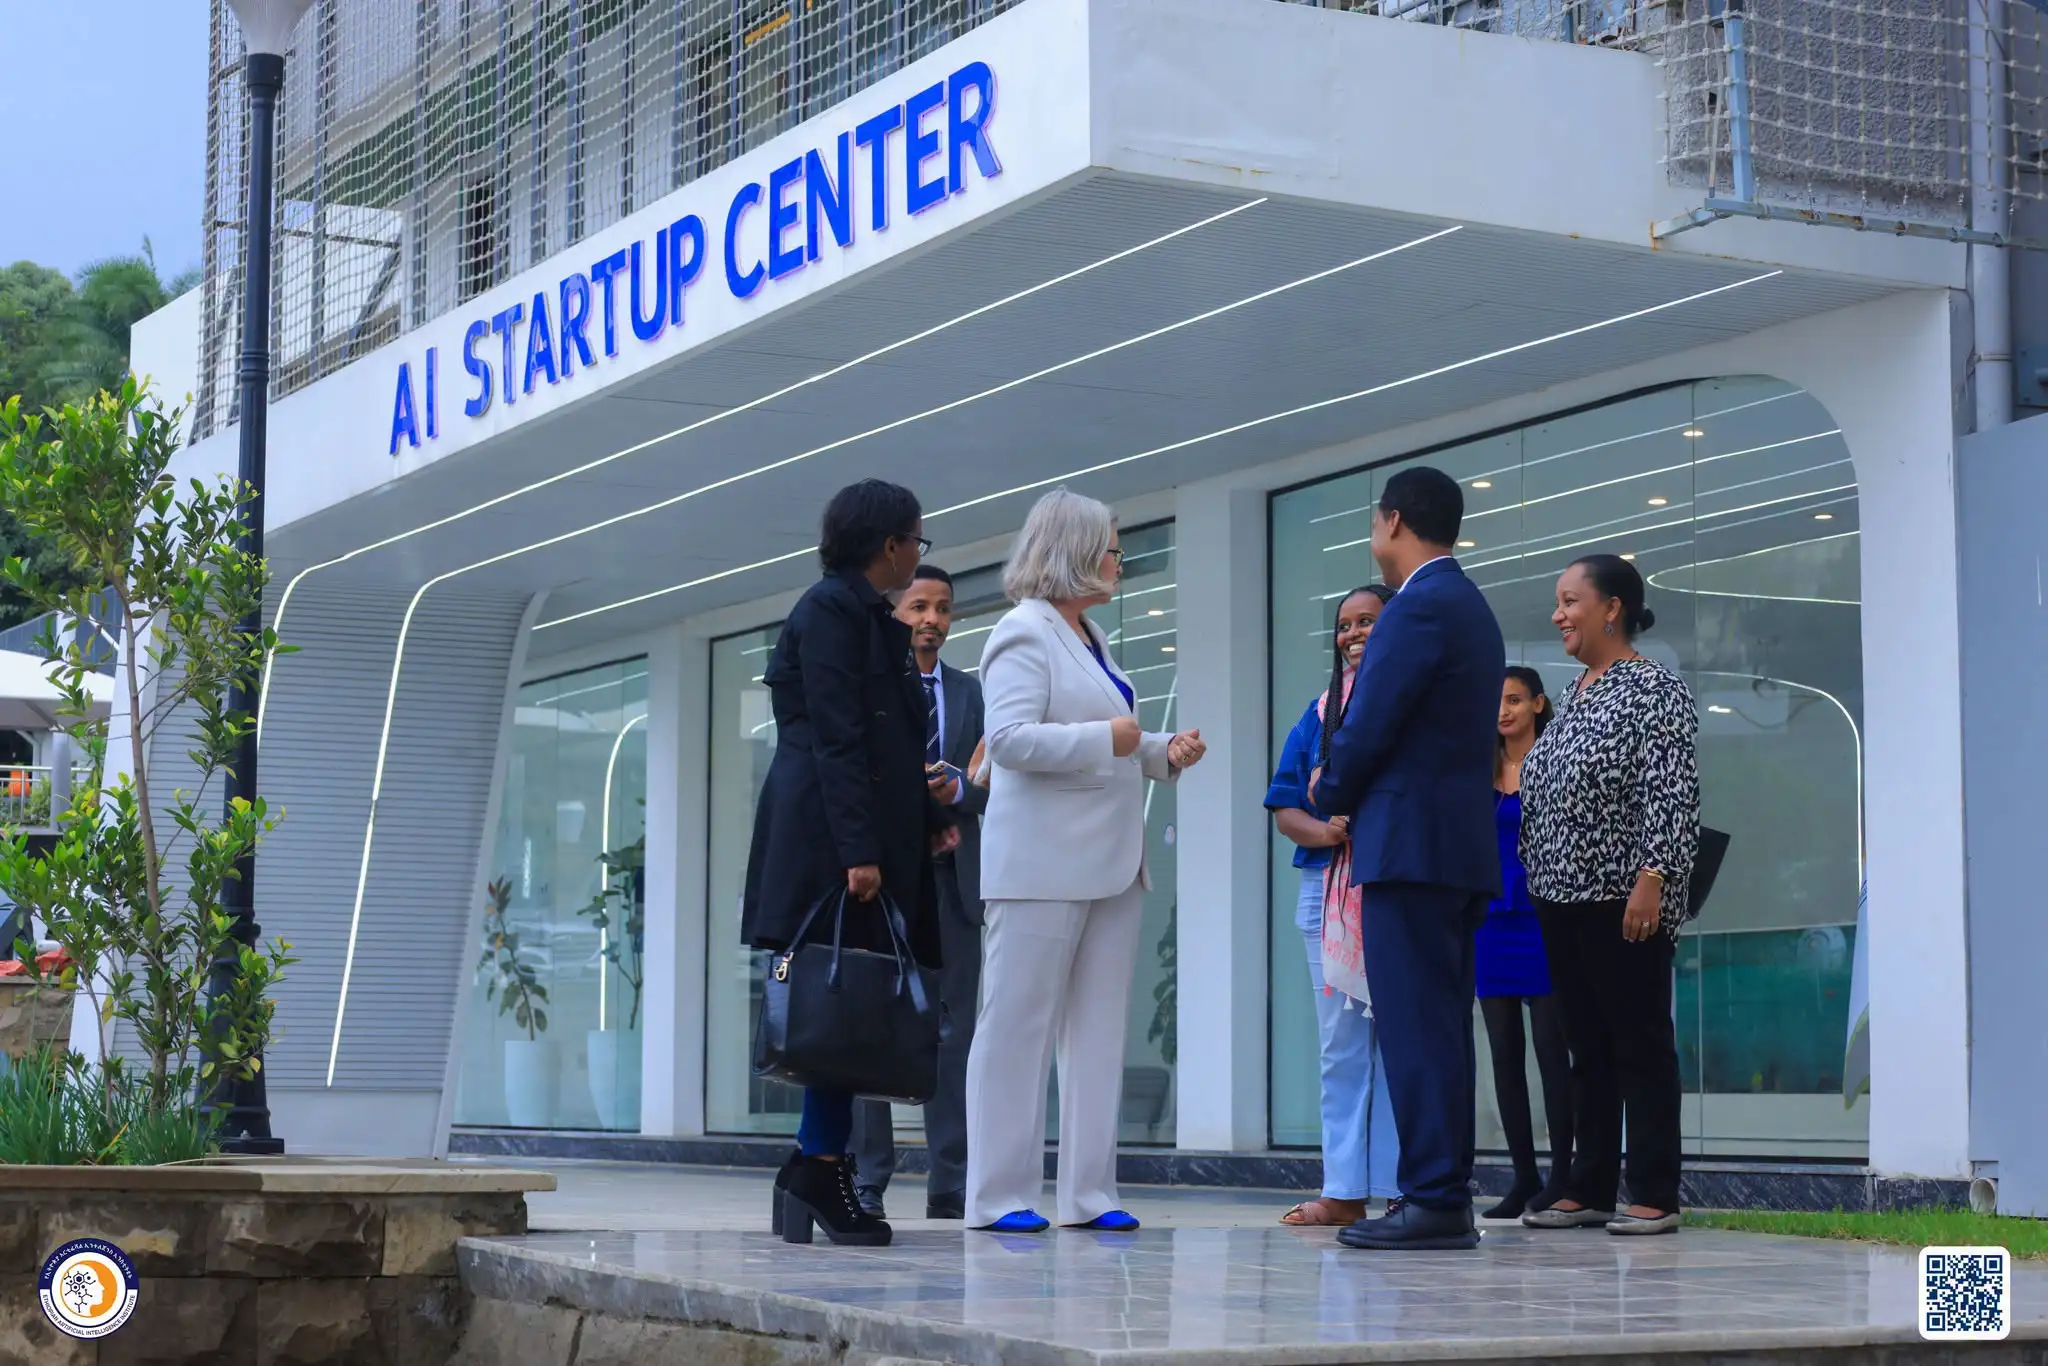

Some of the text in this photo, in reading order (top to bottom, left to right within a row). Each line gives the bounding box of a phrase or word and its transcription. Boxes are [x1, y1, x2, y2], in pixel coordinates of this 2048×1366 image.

[389, 60, 1003, 456] AI STARTUP CENTER
